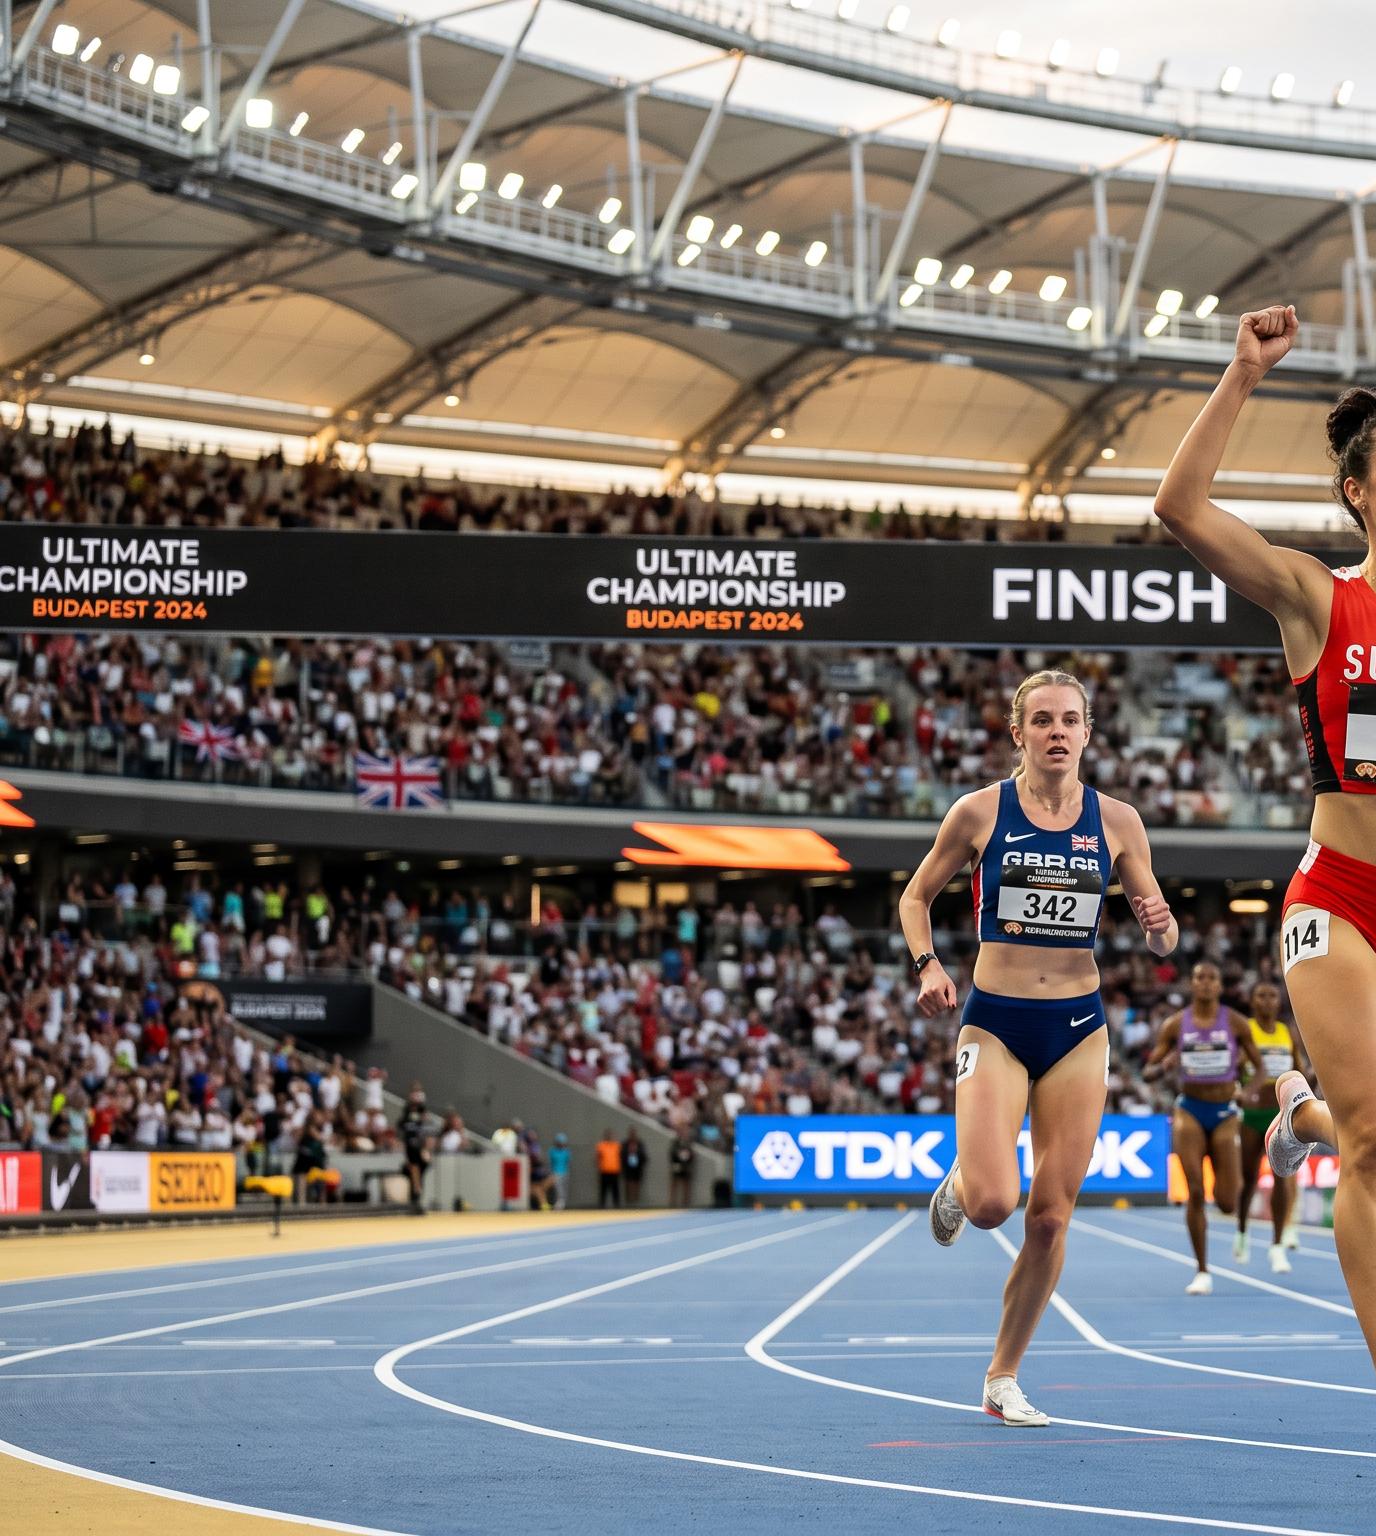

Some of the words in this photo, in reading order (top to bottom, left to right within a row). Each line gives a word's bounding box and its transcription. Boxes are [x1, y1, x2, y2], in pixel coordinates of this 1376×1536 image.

[42, 537, 200, 566] ULTIMATE
[636, 548, 797, 577] ULTIMATE
[0, 566, 248, 596] CHAMPIONSHIP
[586, 577, 846, 608] CHAMPIONSHIP
[32, 598, 149, 619] BUDAPEST
[154, 601, 208, 620] 2024
[992, 568, 1227, 624] FINISH
[626, 609, 745, 630] BUDAPEST
[749, 612, 804, 631] 2024
[1002, 851, 1066, 869] GBR
[1023, 893, 1077, 922] 342
[1285, 919, 1320, 962] 114
[798, 1130, 944, 1179] TDK
